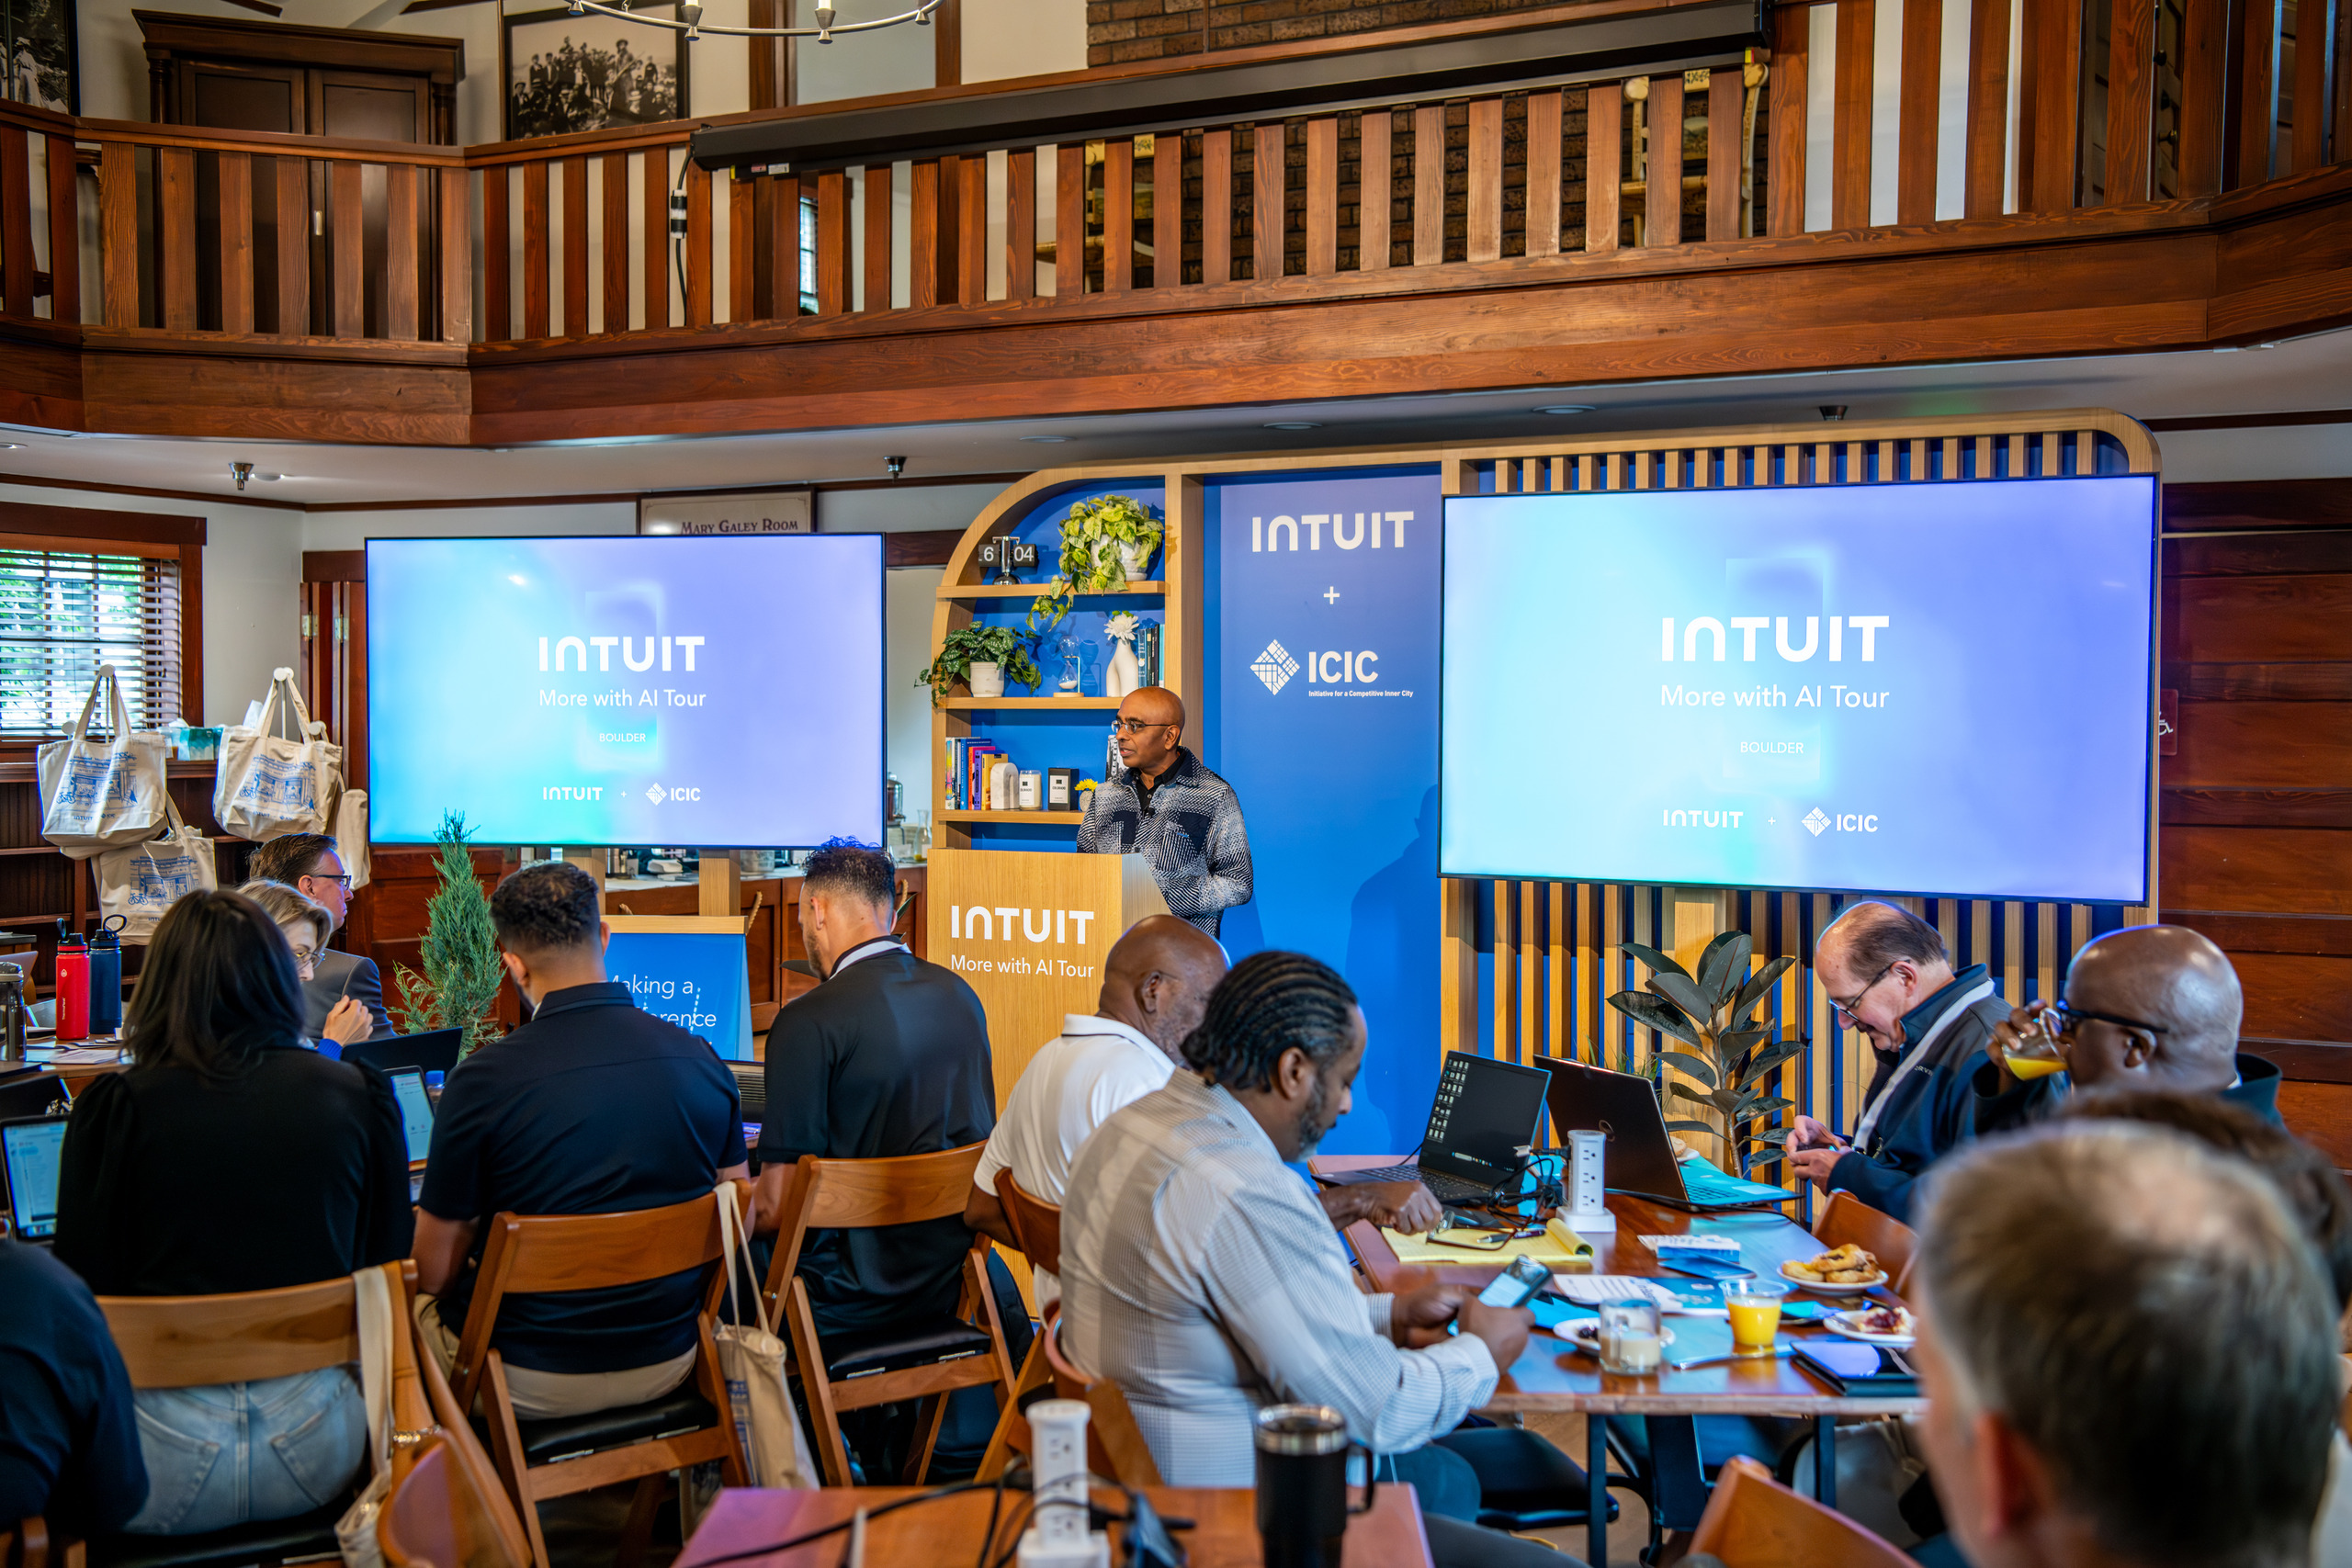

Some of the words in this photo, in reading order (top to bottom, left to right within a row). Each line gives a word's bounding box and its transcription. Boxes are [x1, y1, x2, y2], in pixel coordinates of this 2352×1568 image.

[681, 521, 715, 535] MARY
[718, 519, 759, 533] GALEY
[762, 517, 798, 532] ROOM
[1251, 510, 1415, 553] INTUIT
[983, 546, 994, 562] 6
[1013, 546, 1035, 562] 04
[1661, 615, 1890, 662] INTUIT
[538, 636, 706, 672] INTUIT
[1308, 649, 1379, 683] ICIC
[538, 688, 588, 706] More
[593, 688, 633, 706] with
[638, 689, 658, 706] AI
[663, 689, 707, 707] Tour
[1349, 690, 1384, 698] Competitive
[1401, 690, 1414, 698] City
[1660, 683, 1726, 707] More
[1733, 683, 1787, 707] with
[1794, 684, 1822, 707] AI
[1829, 685, 1890, 708] Tour
[599, 732, 647, 742] BOULDER
[1740, 741, 1804, 754] BOULDER
[542, 786, 604, 801] INTUIT
[670, 787, 701, 802] ICIC
[1662, 808, 1744, 829] INTUIT
[1836, 814, 1879, 833] ICIC
[951, 905, 1095, 945] INTUIT
[951, 953, 993, 974] More
[997, 956, 1032, 976] with
[1035, 958, 1053, 976] AI
[1057, 959, 1095, 978] Tour
[682, 980, 694, 994] a
